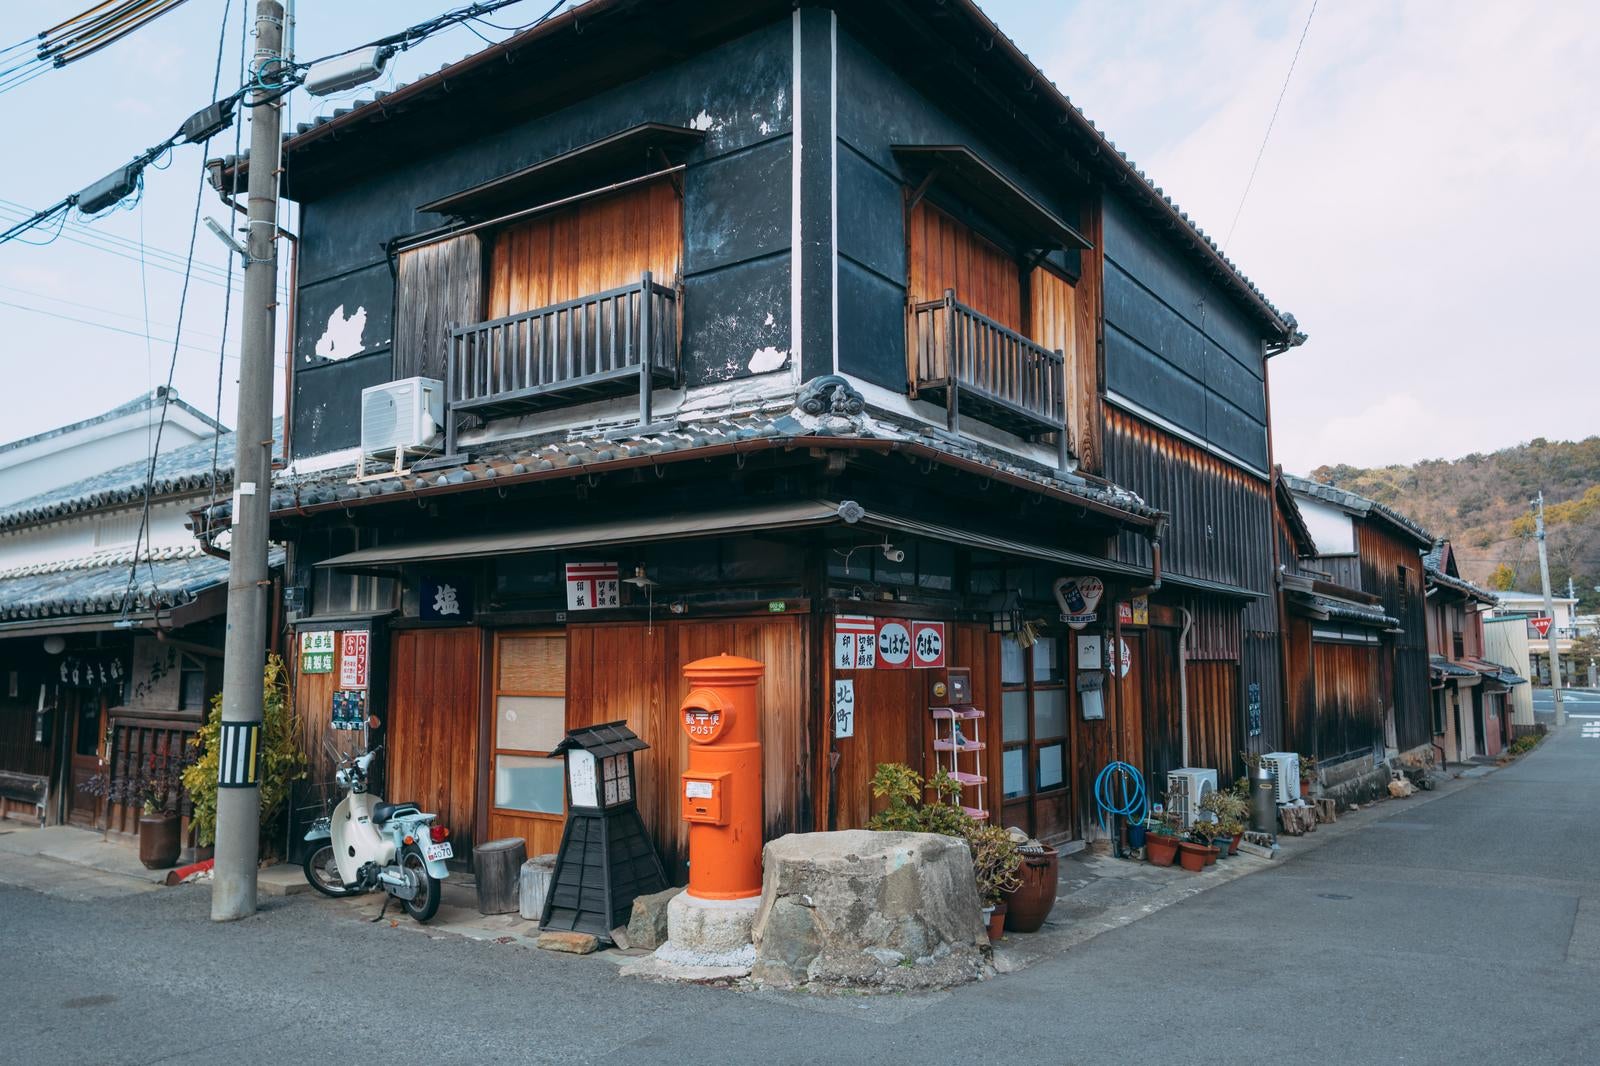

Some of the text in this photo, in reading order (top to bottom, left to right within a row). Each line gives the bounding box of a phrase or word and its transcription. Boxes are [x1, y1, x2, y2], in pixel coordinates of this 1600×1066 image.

[432, 584, 460, 615] 塩
[576, 581, 584, 606] 印紙
[841, 635, 851, 666] 印紙
[916, 633, 940, 656] たばこ
[837, 684, 853, 733] 北町
[690, 726, 714, 734] POST
